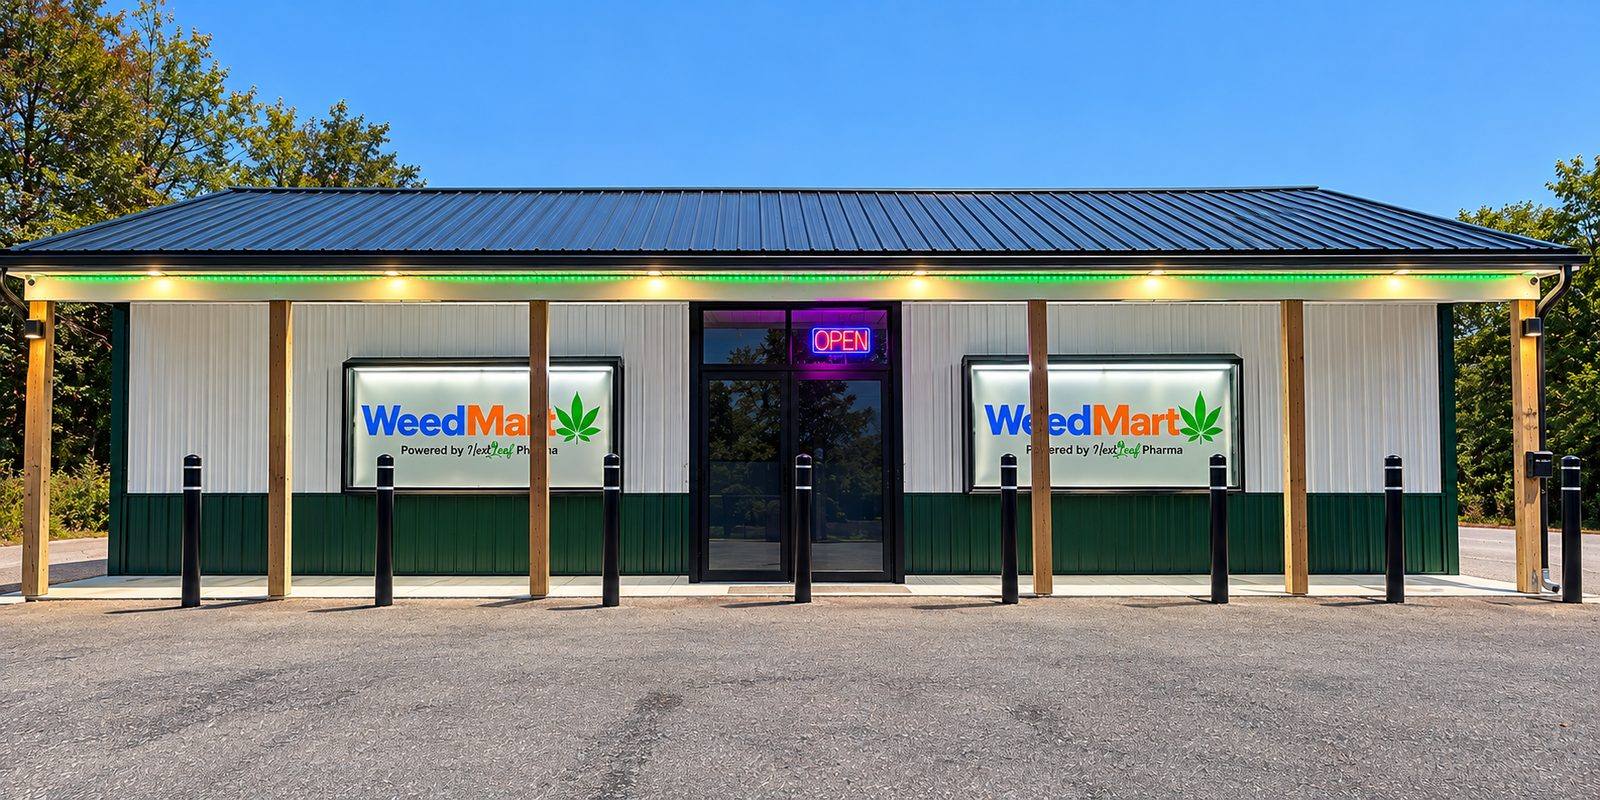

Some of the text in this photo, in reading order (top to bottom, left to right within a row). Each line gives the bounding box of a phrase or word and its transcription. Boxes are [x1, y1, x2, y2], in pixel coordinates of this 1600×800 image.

[815, 330, 868, 351] OPEN
[361, 404, 557, 436] WeedMat
[401, 445, 447, 455] Powered
[451, 445, 464, 458] by
[517, 445, 558, 455] Pha
[1026, 445, 1073, 455] Pered
[1077, 445, 1090, 458] by
[1142, 445, 1183, 455] Pharma
